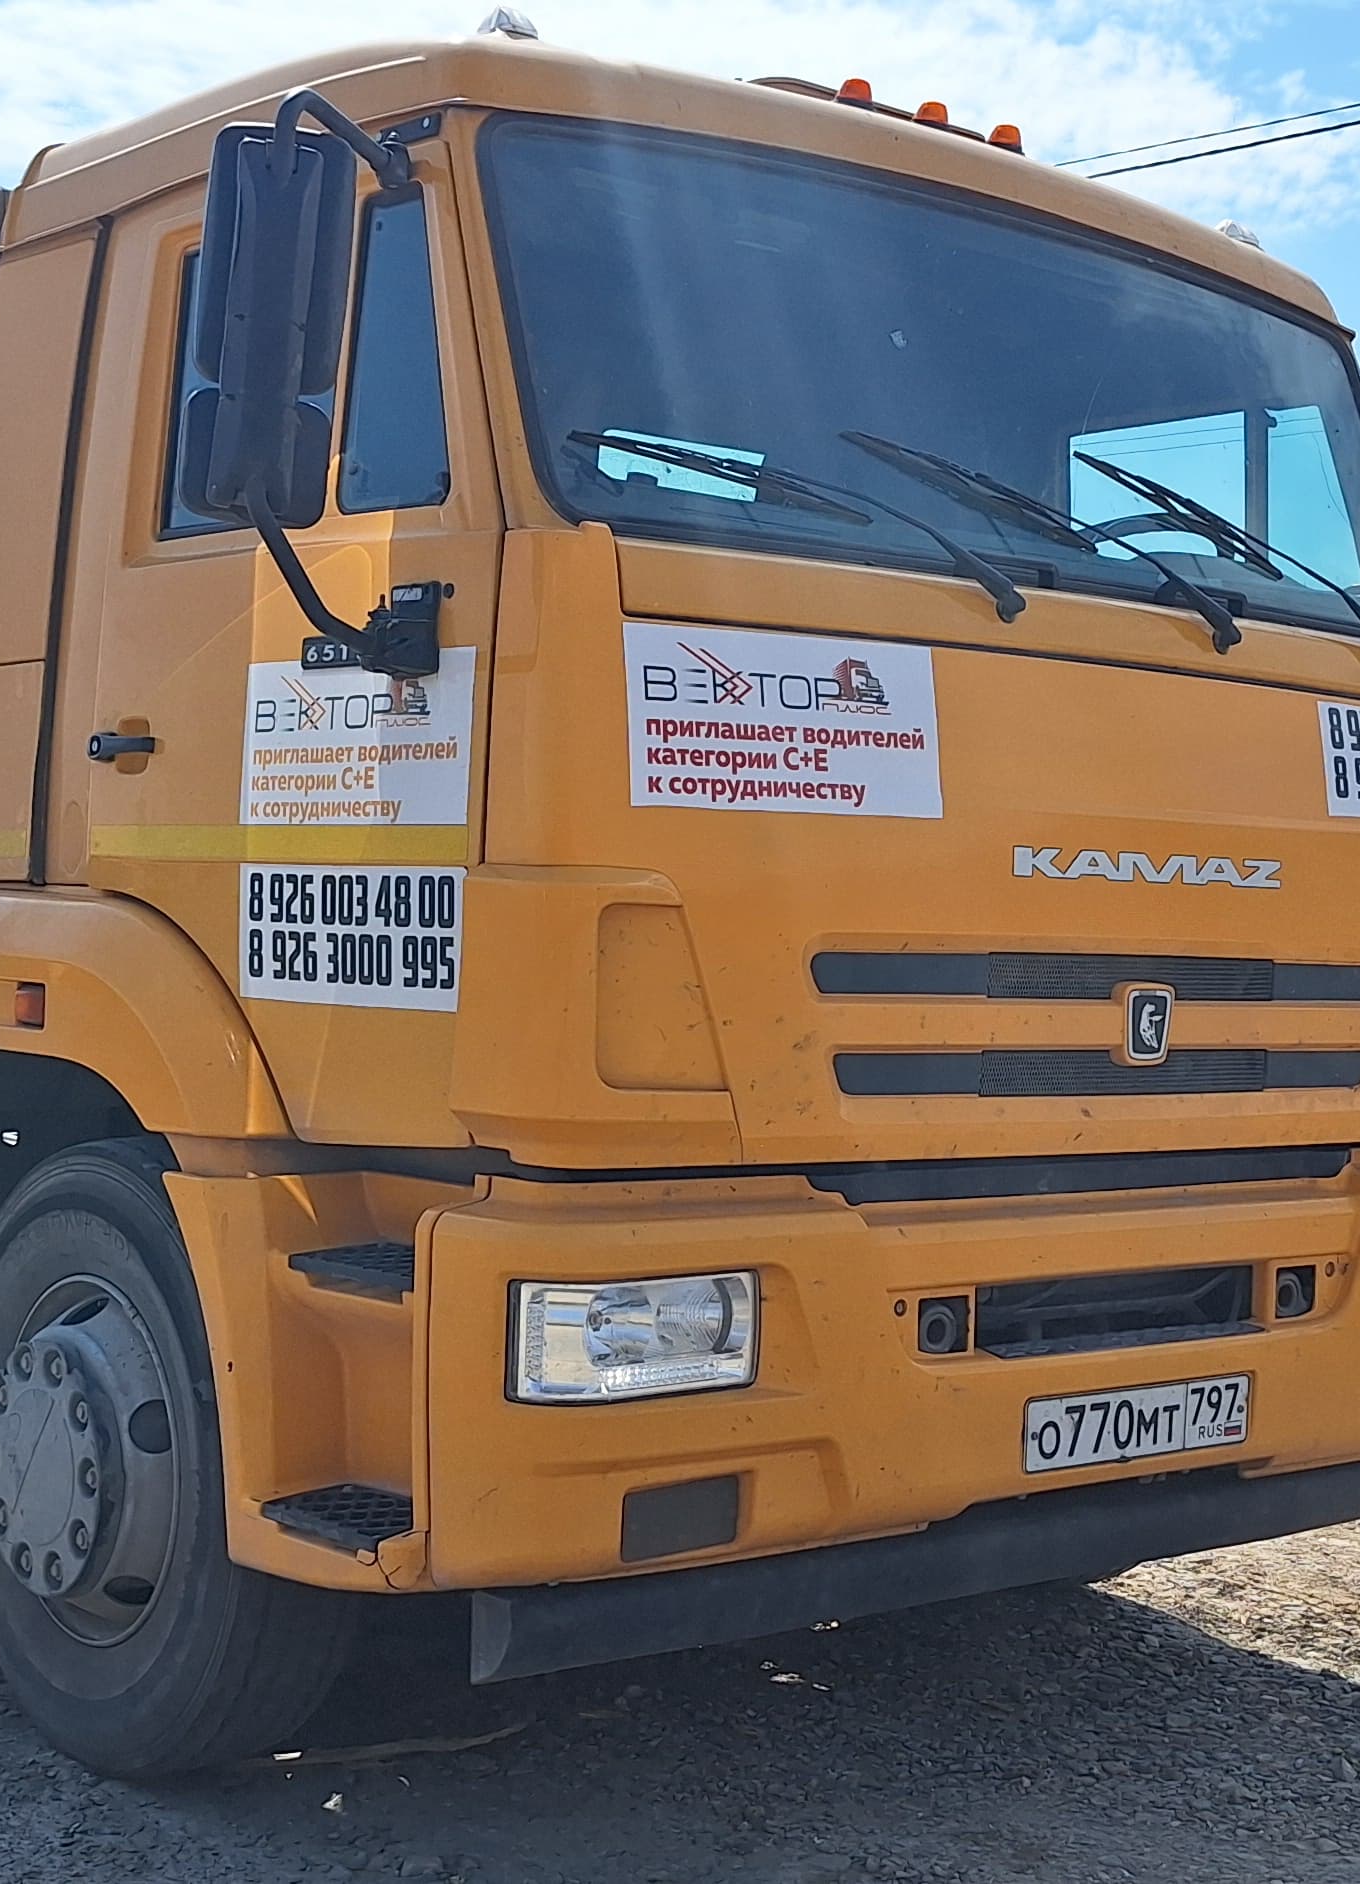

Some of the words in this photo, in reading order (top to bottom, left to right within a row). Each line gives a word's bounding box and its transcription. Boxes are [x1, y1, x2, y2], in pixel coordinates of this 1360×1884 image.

[646, 718, 797, 743] приглашает
[803, 728, 925, 750] водителей
[1328, 708, 1344, 749] 8
[253, 745, 353, 770] приглашает
[357, 736, 458, 765] водителей
[647, 748, 777, 774] категории
[251, 772, 337, 796] категории
[648, 775, 662, 793] к
[669, 776, 866, 806] сотрудничеству
[1334, 756, 1349, 798] 8
[250, 803, 258, 817] к
[262, 800, 402, 823] сотрудничеству
[1013, 846, 1282, 888] KAMAZ
[249, 873, 263, 921] 8
[270, 874, 314, 924] 926
[322, 874, 368, 926] 003
[375, 875, 411, 927] 48
[419, 875, 454, 928] 00
[249, 929, 263, 978] 8
[273, 931, 317, 981] 926
[327, 933, 391, 986] 3000
[403, 936, 454, 989] 995
[1191, 1383, 1240, 1425] 797
[1198, 1424, 1223, 1440] RUS
